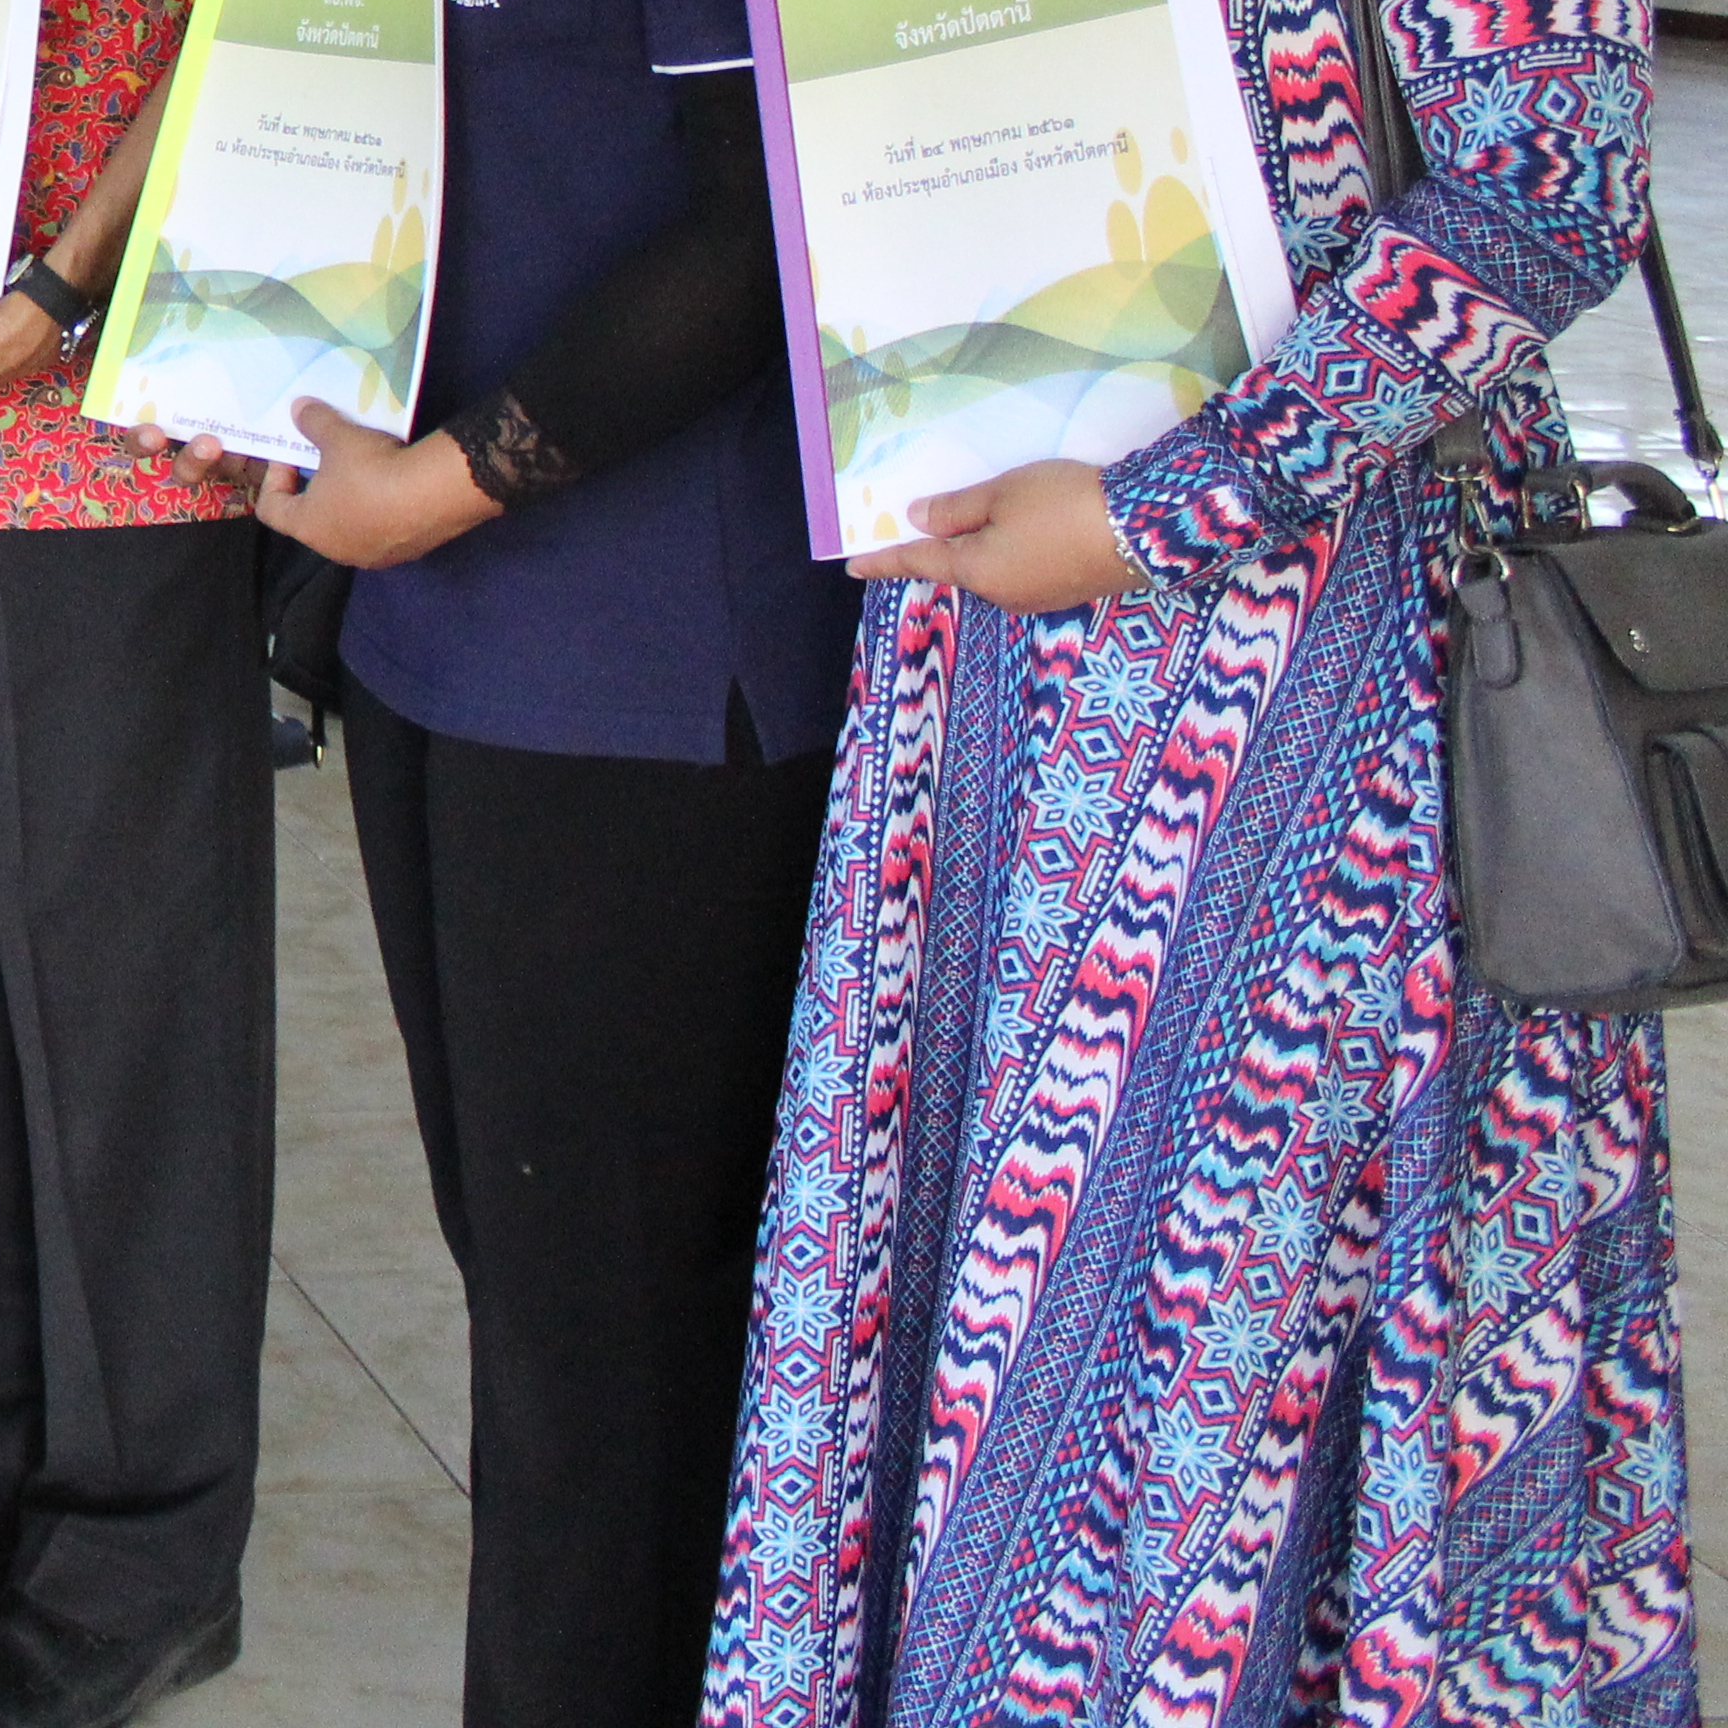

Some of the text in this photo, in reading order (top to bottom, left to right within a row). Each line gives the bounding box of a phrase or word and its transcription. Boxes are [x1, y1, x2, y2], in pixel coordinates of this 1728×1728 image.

[296, 18, 380, 49] จังหวัดปัตตานี
[257, 112, 282, 132] วันที่
[302, 124, 352, 143] พฤษภาคม
[883, 136, 916, 165] วันที่
[949, 124, 1023, 155] พฤษภาคม
[1027, 116, 1076, 137] ๒๕๖๑
[215, 137, 406, 179] ณ ห้องประชุมอำเภอเมือง จังหวัดปัตตานี
[841, 132, 1130, 207] ณ ห้องประชุมอำเภอเมือง จังหวัดปัตตานี
